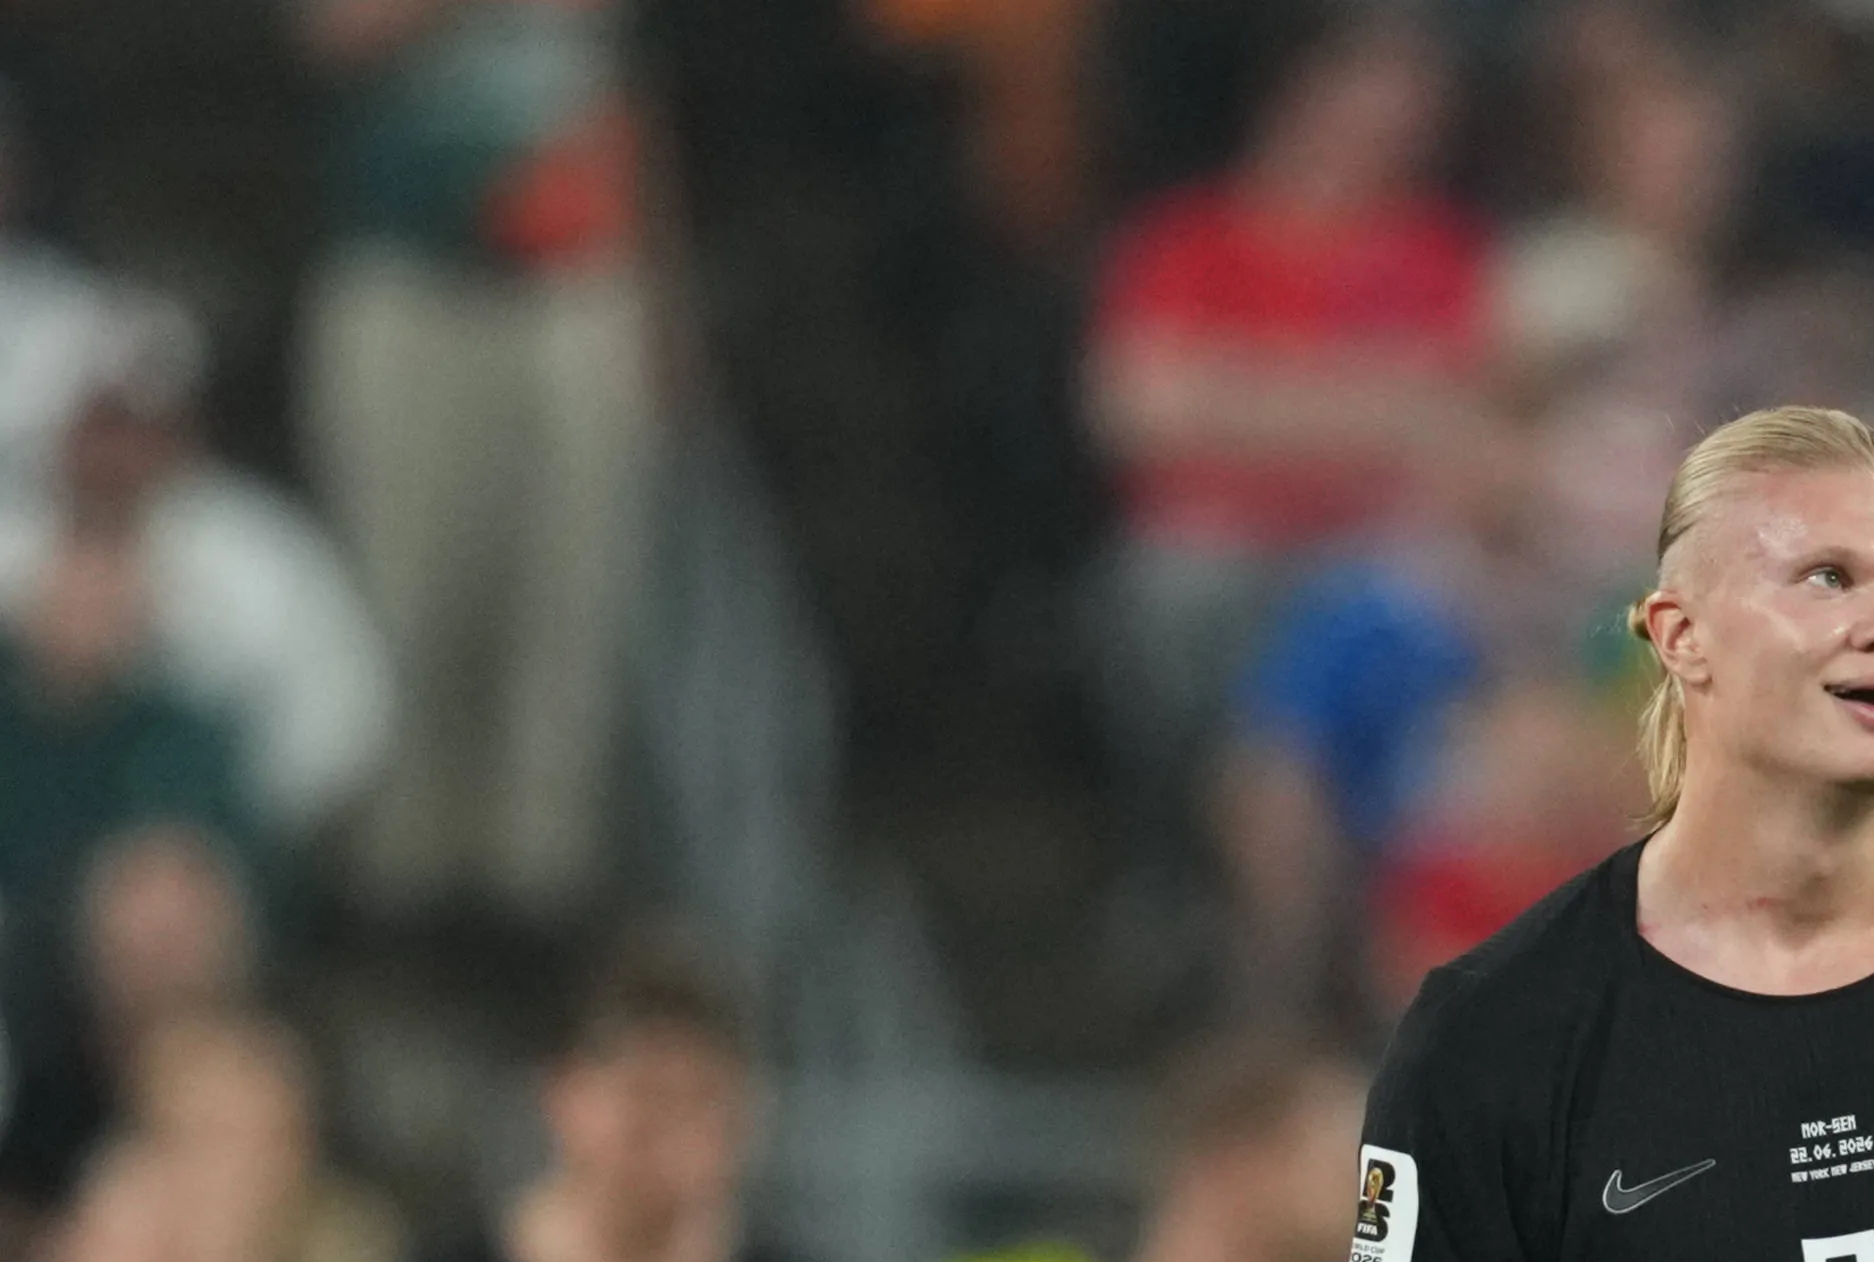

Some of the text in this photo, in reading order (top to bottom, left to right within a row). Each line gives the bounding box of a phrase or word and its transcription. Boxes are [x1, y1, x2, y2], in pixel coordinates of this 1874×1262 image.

[1801, 1115, 1857, 1139] NOR-SEN
[1791, 1171, 1808, 1183] NEW
[1809, 1167, 1830, 1180] YORK
[1831, 1164, 1847, 1177] NEW
[1357, 1222, 1378, 1236] FIFA
